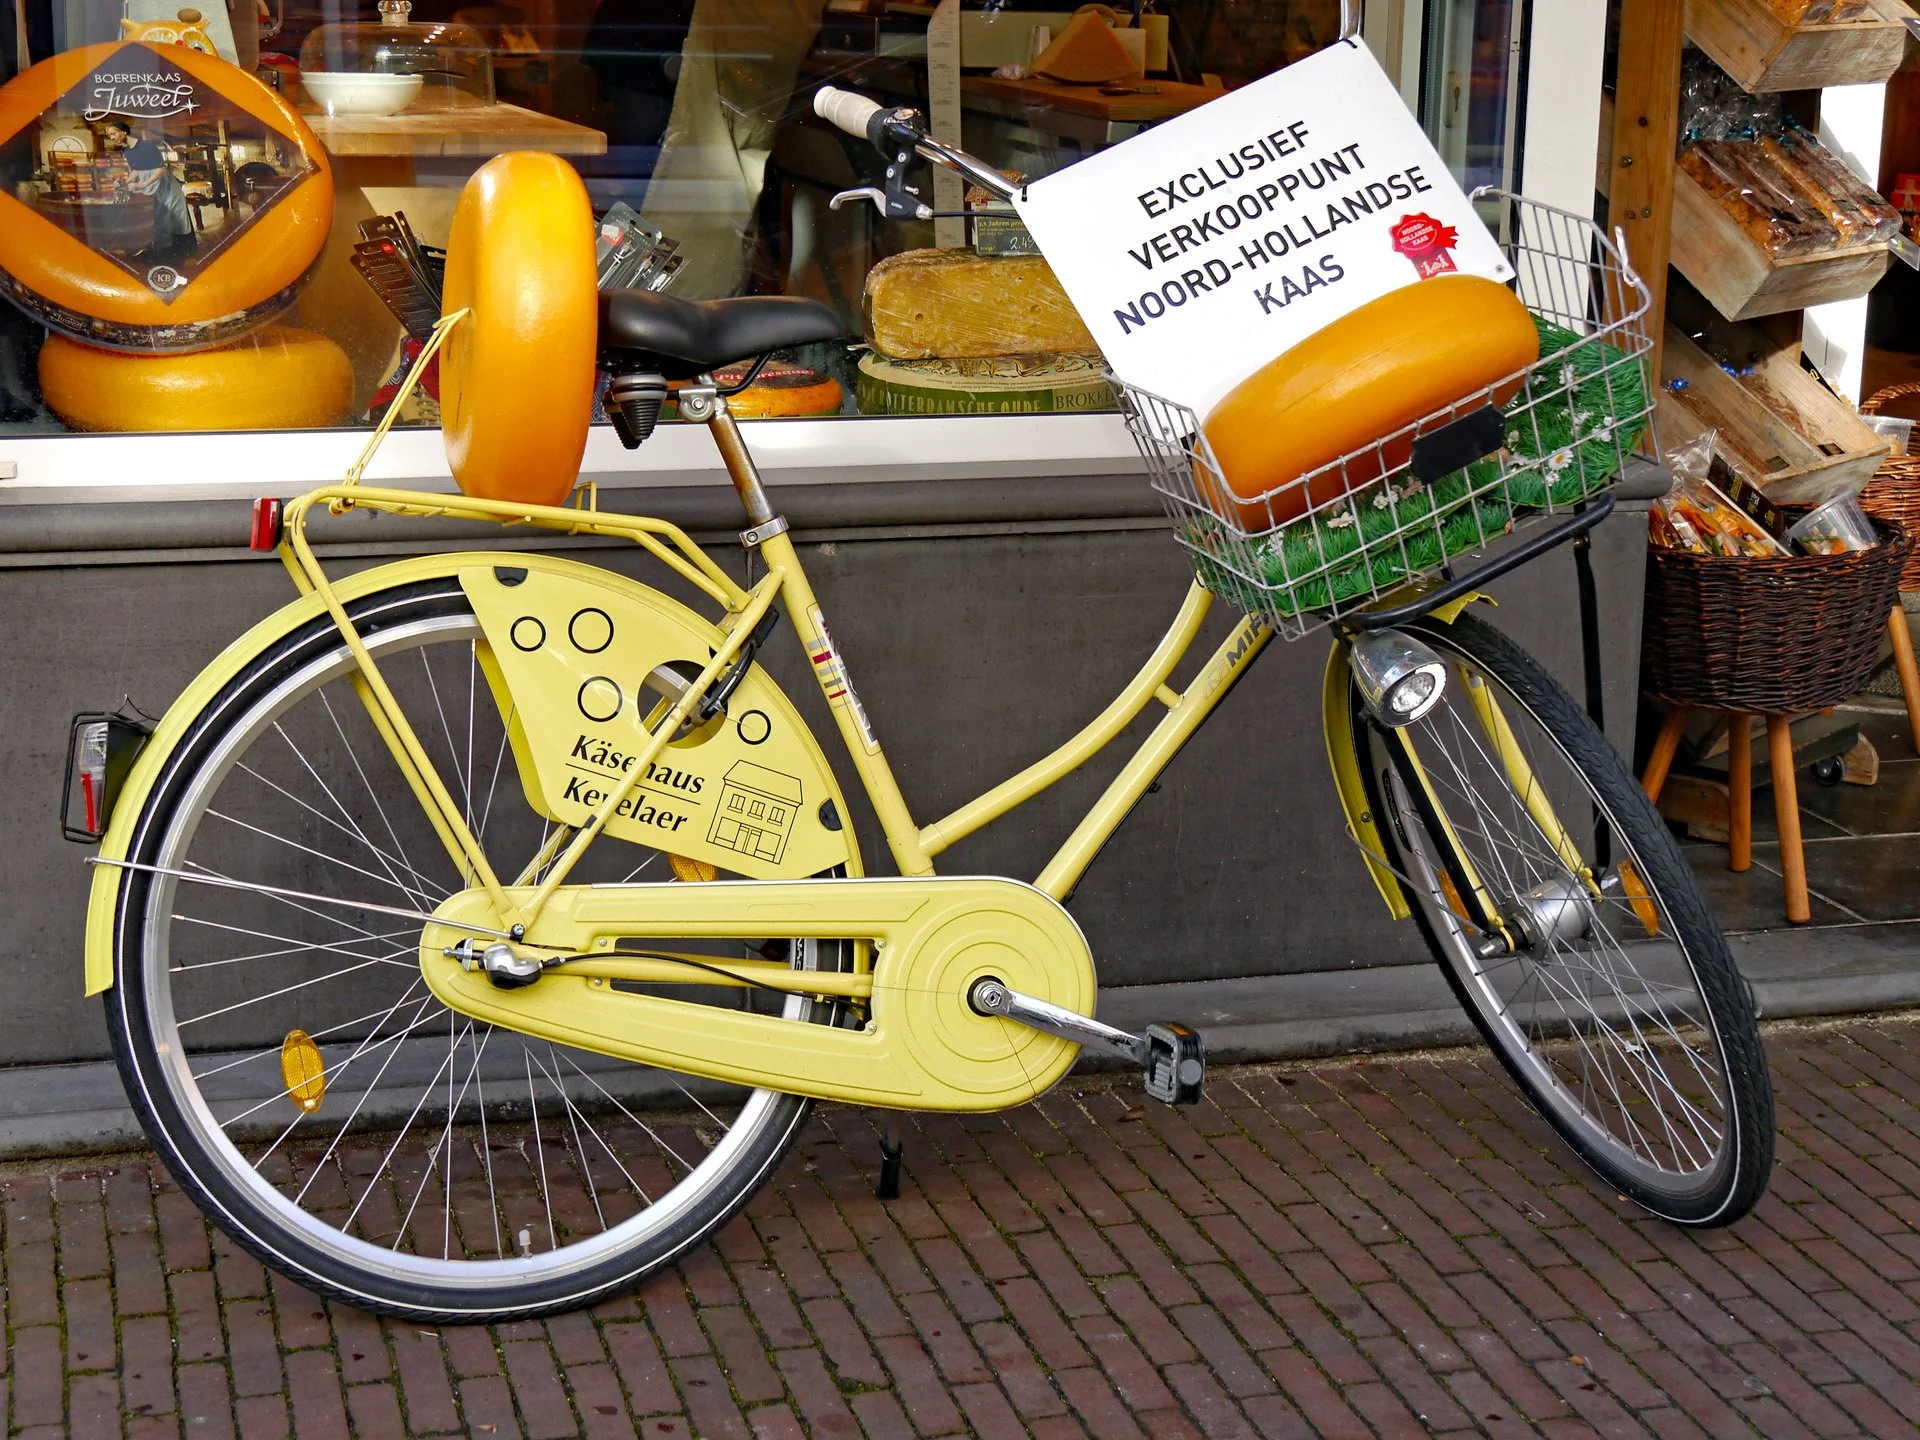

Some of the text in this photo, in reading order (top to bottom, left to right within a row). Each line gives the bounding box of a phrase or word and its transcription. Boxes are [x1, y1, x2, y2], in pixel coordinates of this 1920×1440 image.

[86, 85, 193, 120] Juweel
[94, 73, 181, 84] BOERENKAAS
[1128, 143, 1366, 271] VERKOOPPUNT
[1137, 120, 1310, 219] EXCLUSIEF
[1113, 166, 1432, 335] NOORD-HOLLANDSE
[1253, 254, 1344, 315] KAAS
